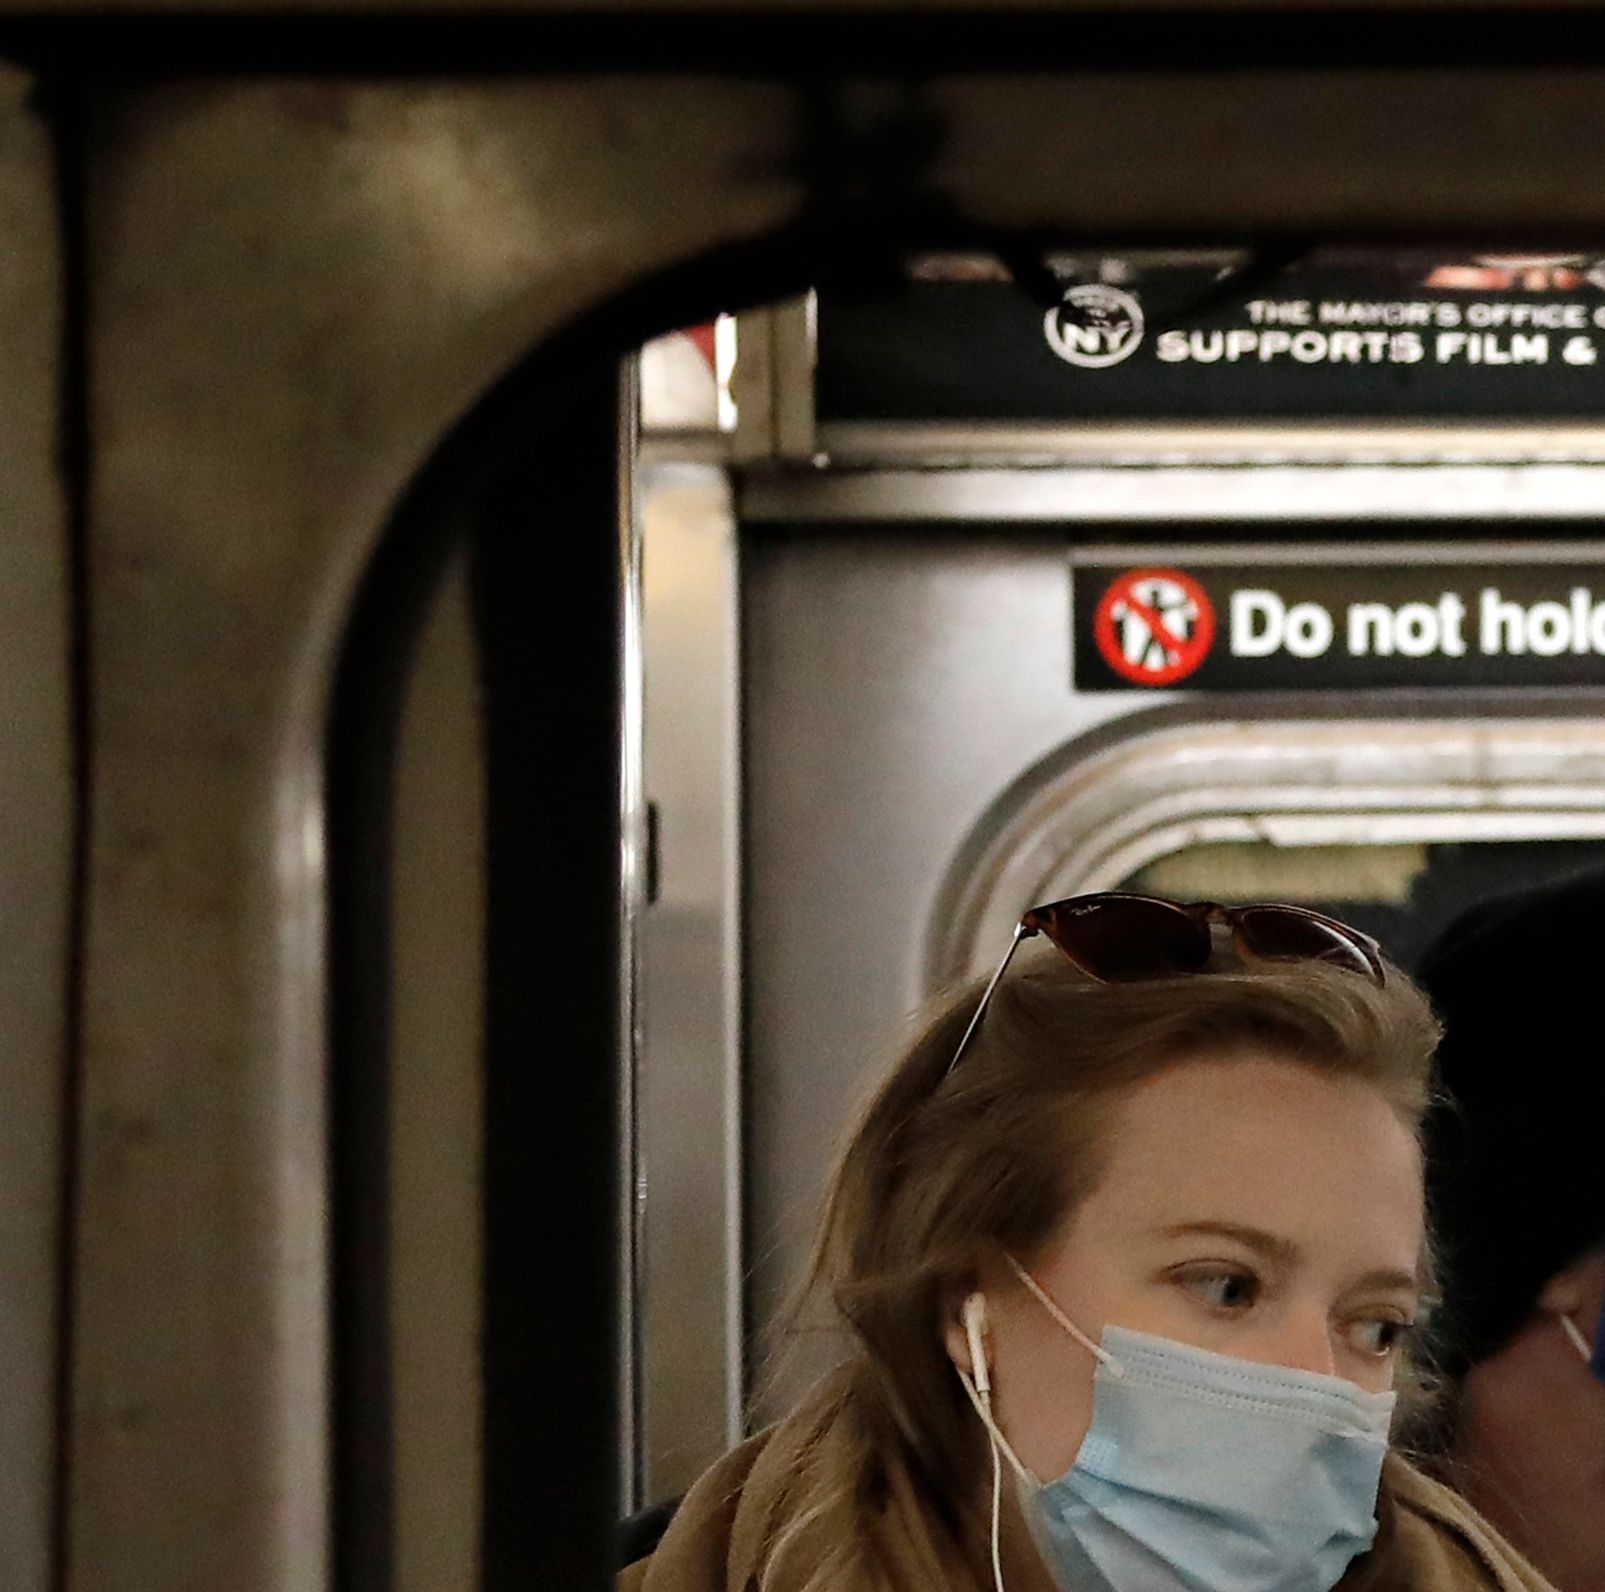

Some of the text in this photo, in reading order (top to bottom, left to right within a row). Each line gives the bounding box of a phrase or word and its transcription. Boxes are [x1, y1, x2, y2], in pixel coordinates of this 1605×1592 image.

[1246, 300, 1311, 325] THE
[1318, 301, 1461, 327] MAYOR'S
[1466, 302, 1588, 328] OFFICE
[1156, 329, 1424, 363] SUPPORTS
[1435, 332, 1549, 365] FILM
[1562, 335, 1598, 365] &
[1229, 588, 1334, 658] Do
[1347, 591, 1467, 657] not
